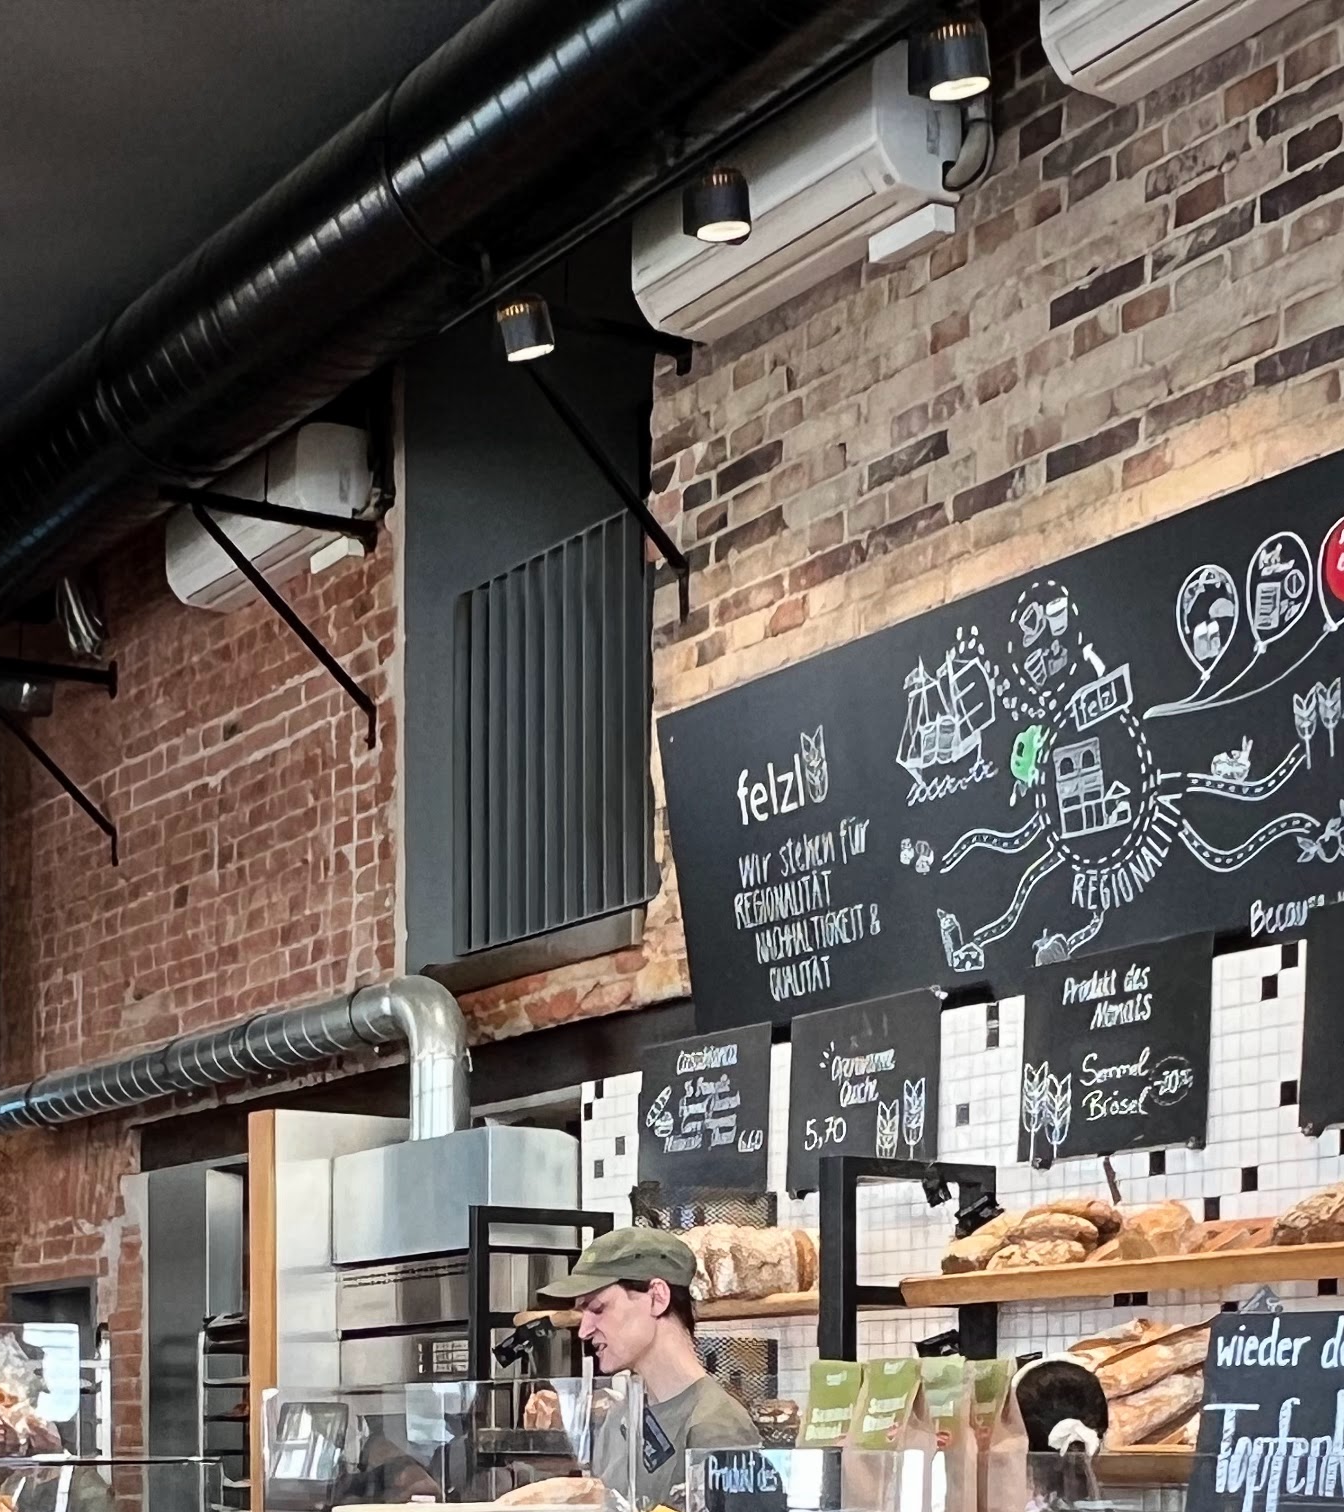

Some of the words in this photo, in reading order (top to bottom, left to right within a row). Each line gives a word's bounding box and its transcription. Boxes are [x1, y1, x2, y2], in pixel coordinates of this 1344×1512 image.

[737, 753, 805, 825] felzl
[840, 816, 870, 864] für
[734, 870, 832, 929] REGIONALITÄT
[769, 955, 831, 1001] QUALITÄT
[1124, 963, 1151, 992] des
[804, 1115, 847, 1151] 5,70
[1216, 1316, 1311, 1367] wieder
